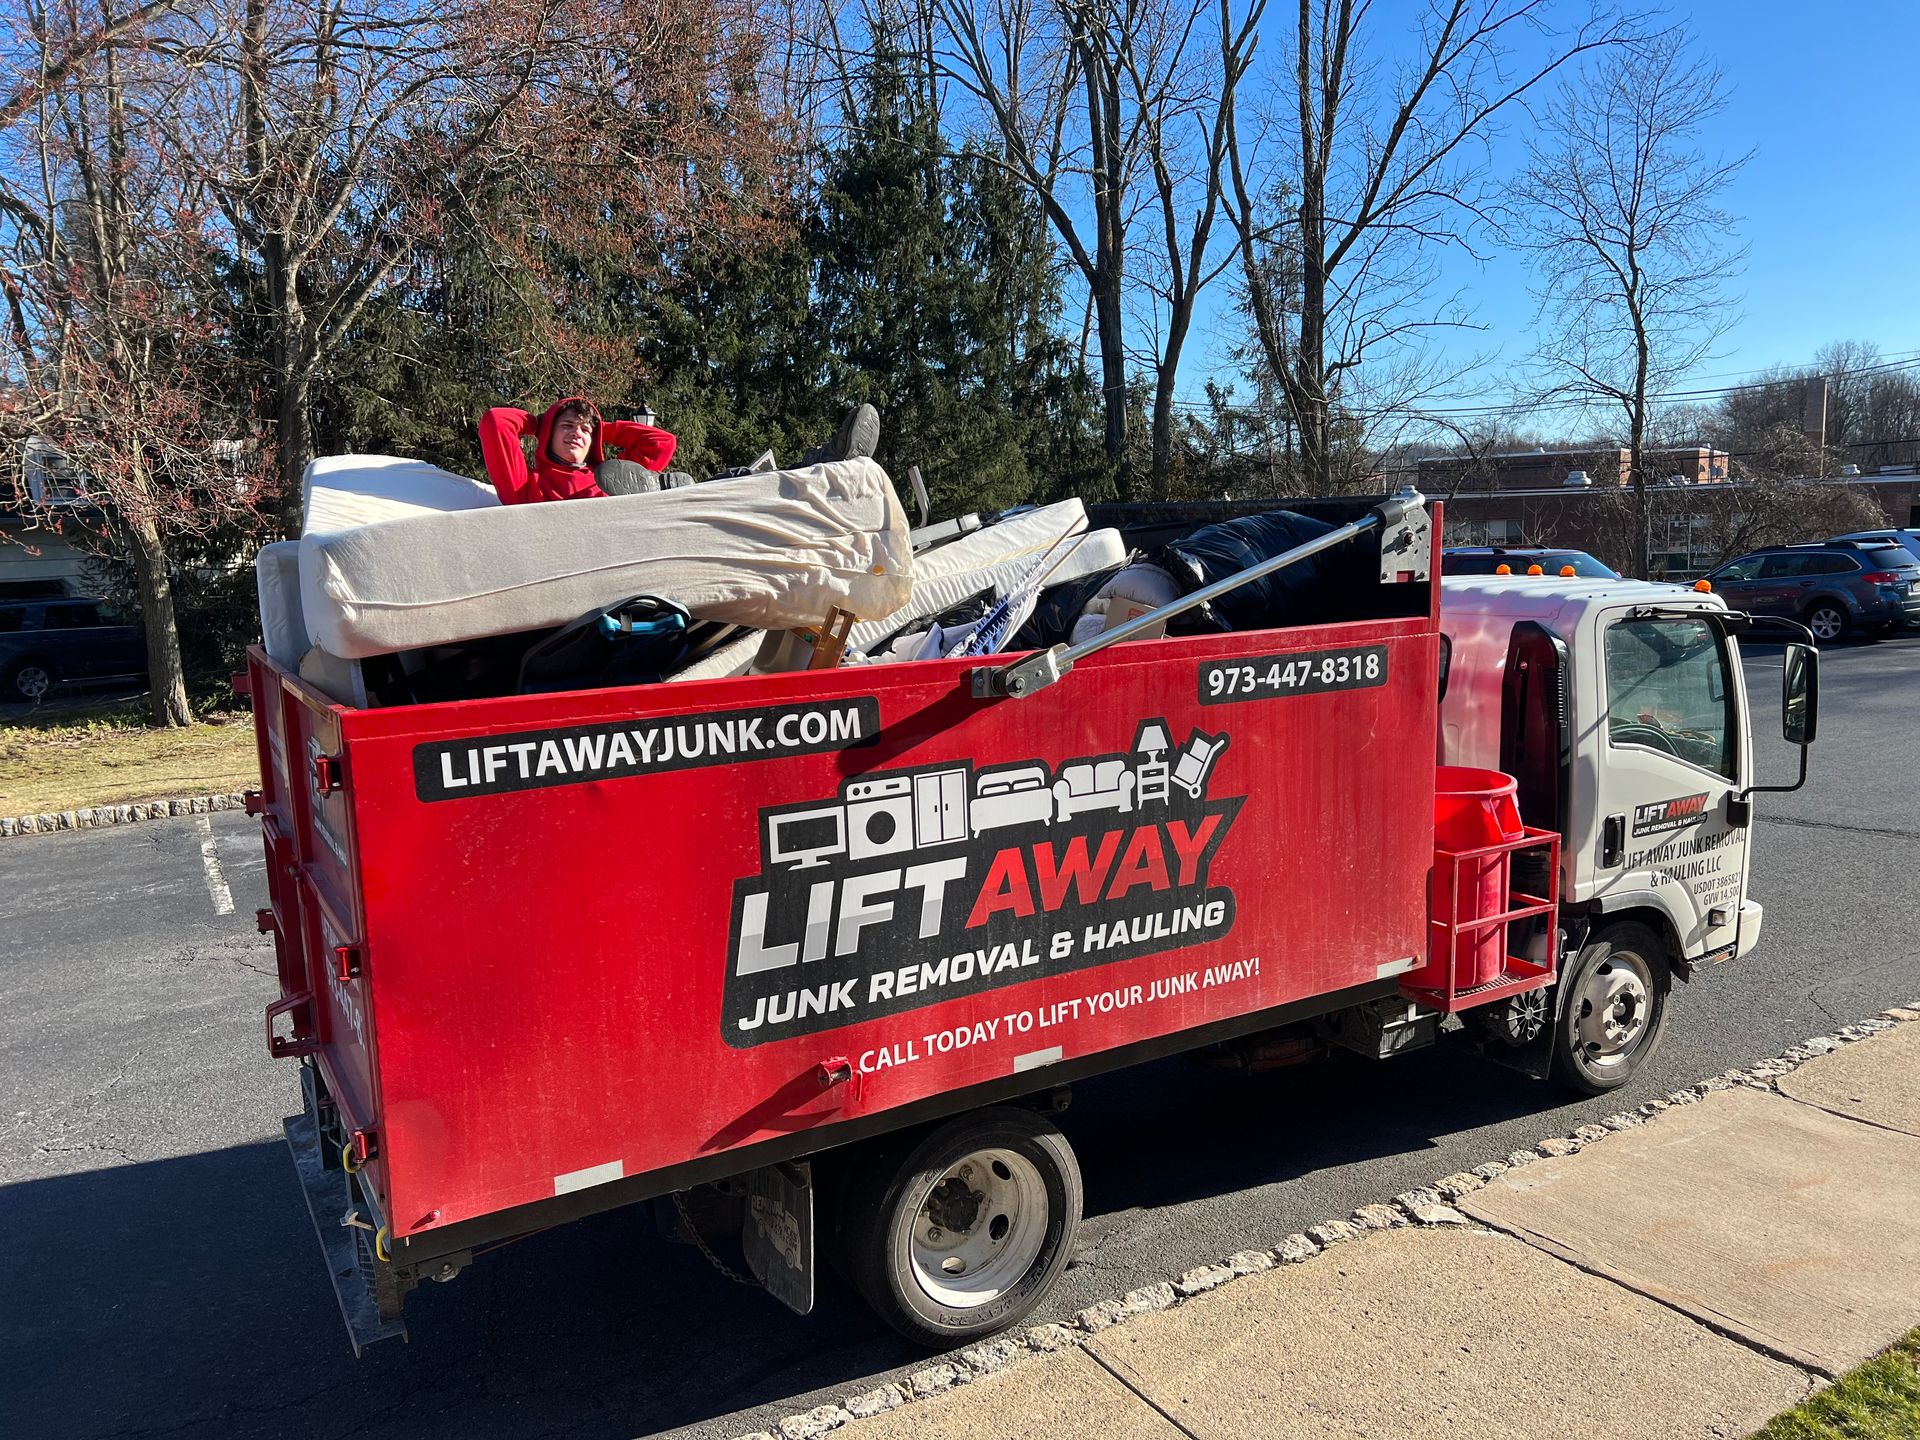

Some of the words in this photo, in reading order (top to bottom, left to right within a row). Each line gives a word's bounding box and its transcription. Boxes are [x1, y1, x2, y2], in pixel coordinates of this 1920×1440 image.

[1208, 653, 1380, 697] 973-447-8318
[440, 707, 862, 788] LIFTAWAYJUNK.COM
[1634, 803, 1668, 825] LIFT
[1665, 794, 1707, 819] AWAY
[1634, 827, 1650, 835] JUNK
[1651, 821, 1676, 832] REMOVAL
[1622, 849, 1645, 871] LIFT
[1645, 842, 1677, 866] AWAY
[1677, 836, 1704, 858] JUNK
[1705, 826, 1745, 852] REMOVAL
[1650, 870, 1659, 888] &
[1660, 858, 1705, 886] HAULING
[1706, 855, 1722, 875] LLC
[1693, 878, 1716, 895] USDOT
[736, 856, 968, 977] LIFT
[964, 814, 1224, 929] AWAY
[1703, 890, 1719, 906] GVW
[738, 978, 859, 1031] JUNK
[868, 939, 1040, 1003] REMOVAL
[1050, 931, 1075, 960] &
[1083, 900, 1226, 952] HAULING
[859, 1040, 920, 1073] CALL
[922, 1017, 1000, 1056] TODAY
[1003, 1011, 1034, 1036] TO
[1038, 999, 1083, 1028] LIFT
[1085, 985, 1143, 1016] YOUR
[1146, 971, 1199, 1002] JUNK
[1202, 957, 1261, 988] AWAY!
